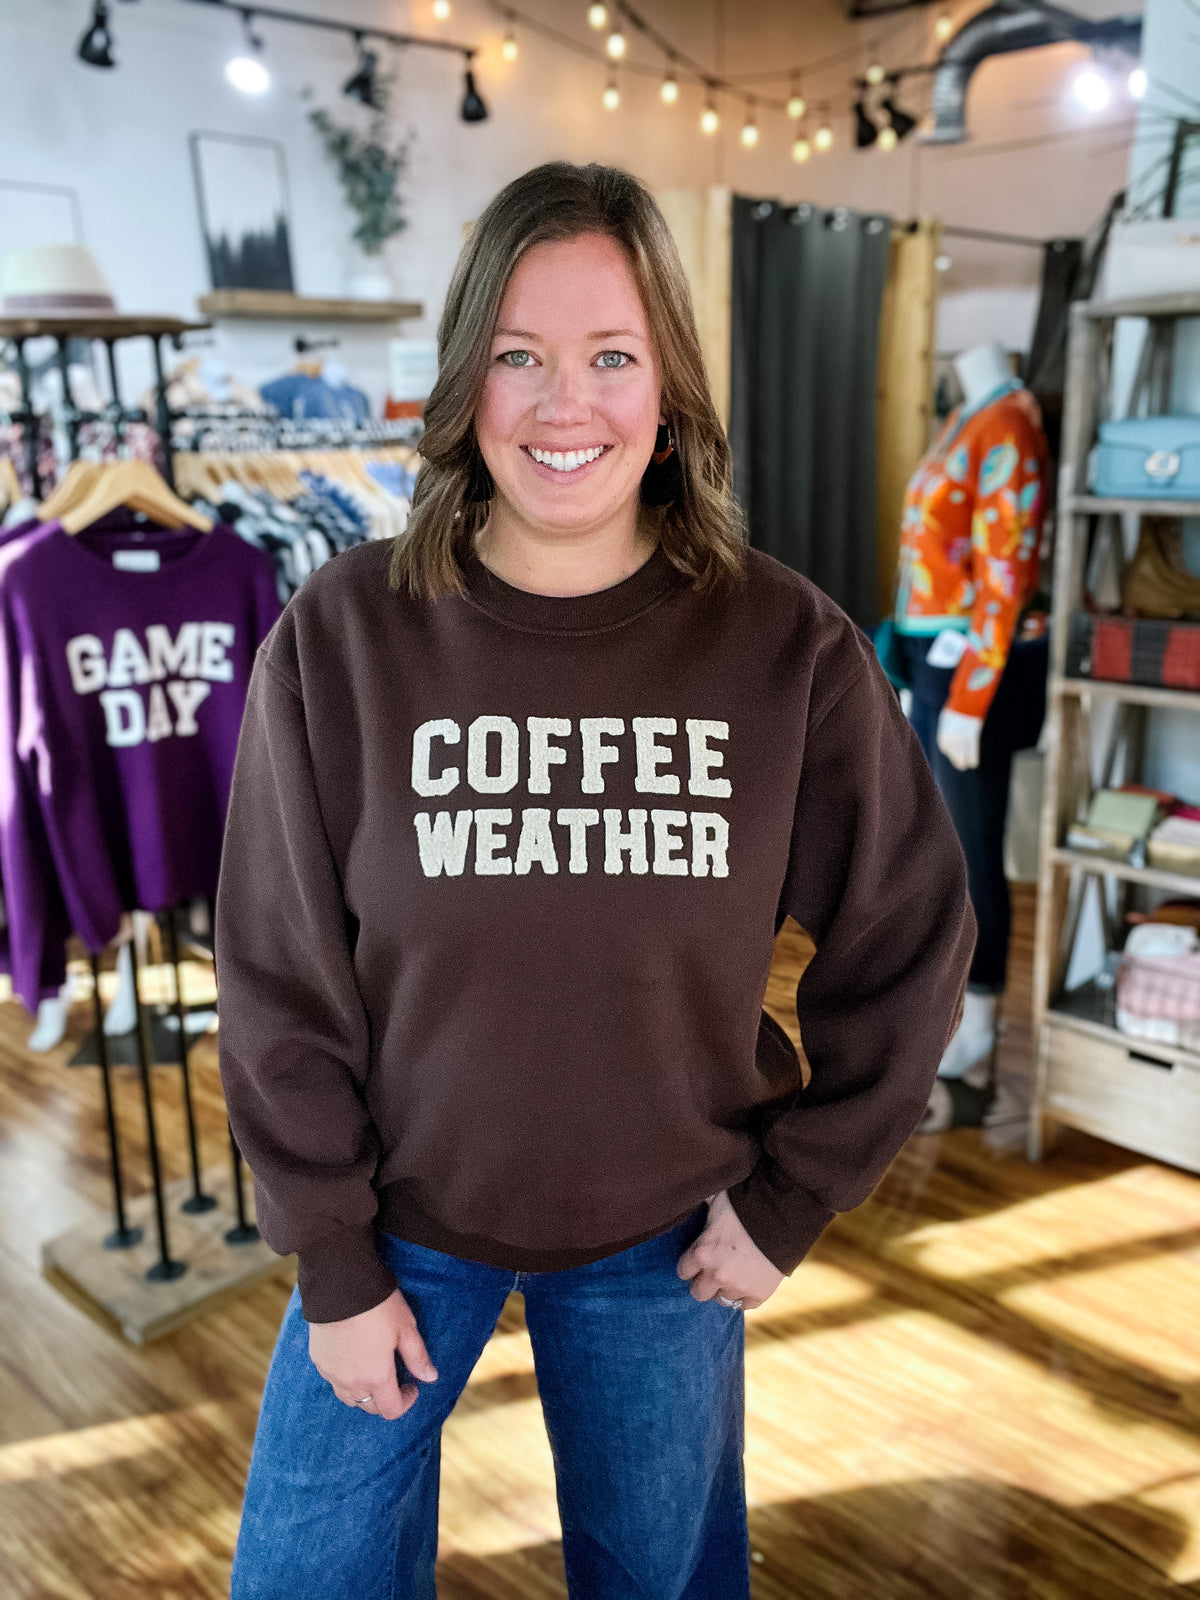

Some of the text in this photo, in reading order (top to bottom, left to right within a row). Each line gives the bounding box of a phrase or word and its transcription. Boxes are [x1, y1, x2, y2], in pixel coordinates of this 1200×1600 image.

[66, 621, 235, 695] GAME
[99, 680, 211, 748] DAY
[411, 715, 733, 798] COFFEE
[413, 808, 730, 877] WEATHER
